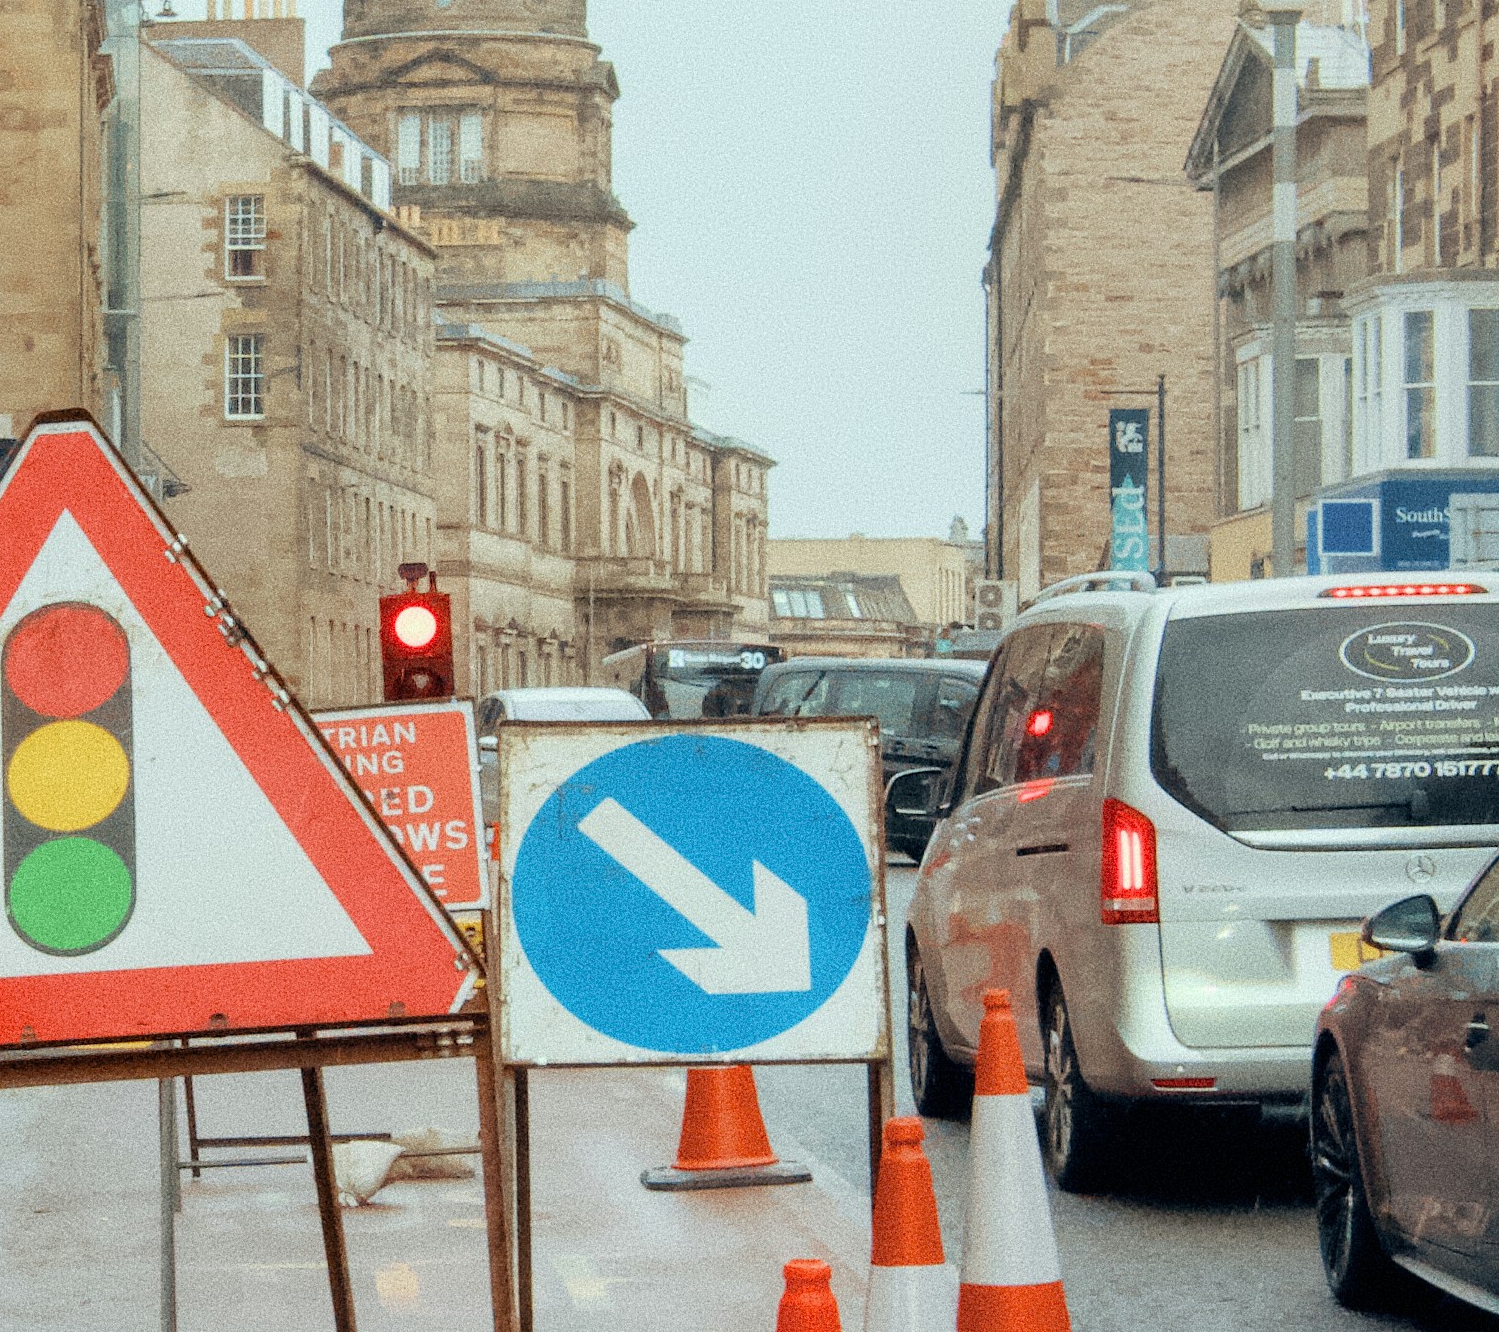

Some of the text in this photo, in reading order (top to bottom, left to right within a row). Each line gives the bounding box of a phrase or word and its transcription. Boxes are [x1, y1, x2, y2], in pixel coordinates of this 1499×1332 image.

[1111, 484, 1146, 571] SEd
[1367, 632, 1417, 645] Luxury
[1391, 644, 1435, 657] Travel
[740, 651, 765, 669] 30
[1410, 657, 1451, 669] Tours
[1300, 688, 1372, 701] Executive
[1373, 688, 1383, 699] 7
[1385, 686, 1435, 699] Seater
[1435, 685, 1488, 698] Vehicle
[1344, 699, 1478, 714] Professional Driver
[1248, 723, 1292, 735] Private
[1293, 723, 1330, 736] group
[1332, 721, 1367, 732] tours
[1379, 719, 1423, 732] Airport
[1424, 717, 1481, 729] transfers
[1253, 737, 1281, 749] Golf
[1282, 736, 1307, 749] and
[1307, 735, 1351, 748] whisky
[1353, 734, 1381, 748] trips
[1394, 733, 1459, 746] Corporate
[1460, 731, 1484, 743] and
[1324, 763, 1369, 780] +44
[1370, 761, 1431, 779] 7870
